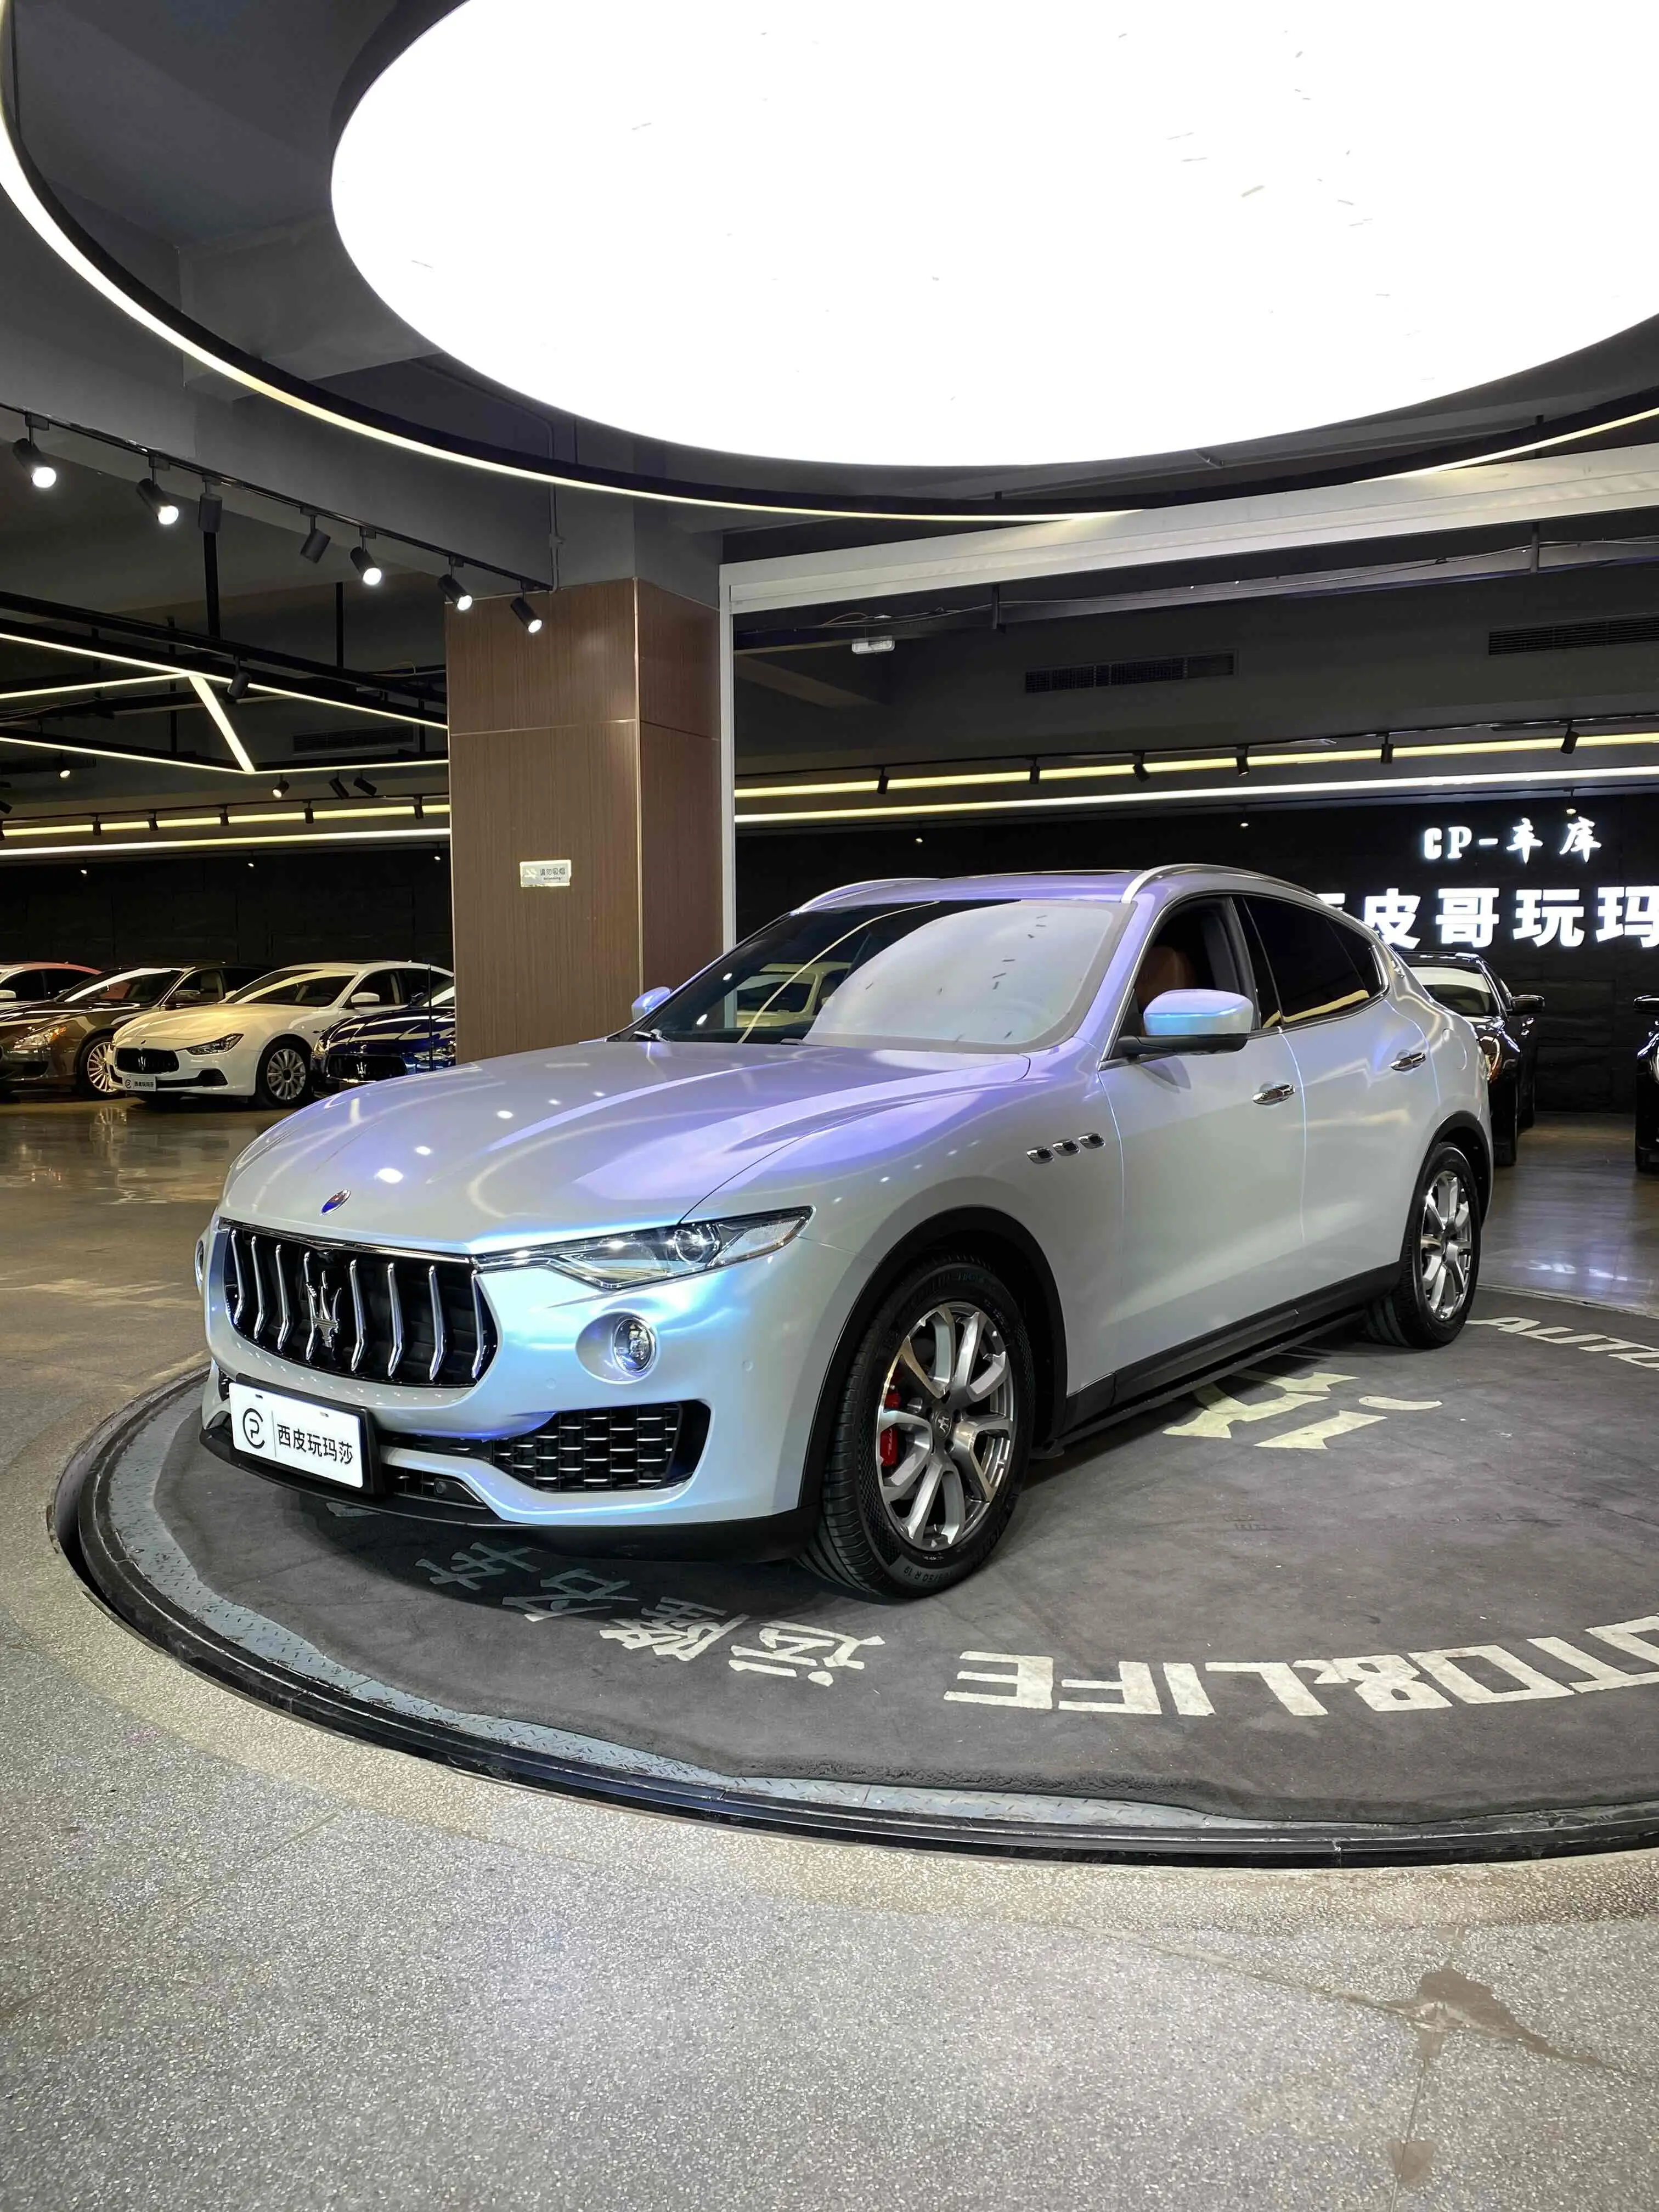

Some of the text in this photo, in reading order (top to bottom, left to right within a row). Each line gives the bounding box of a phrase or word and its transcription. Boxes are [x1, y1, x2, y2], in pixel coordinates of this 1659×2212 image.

[1317, 884, 1659, 949] 皮哥玩玛
[276, 1423, 354, 1465] 西皮玩玛莎
